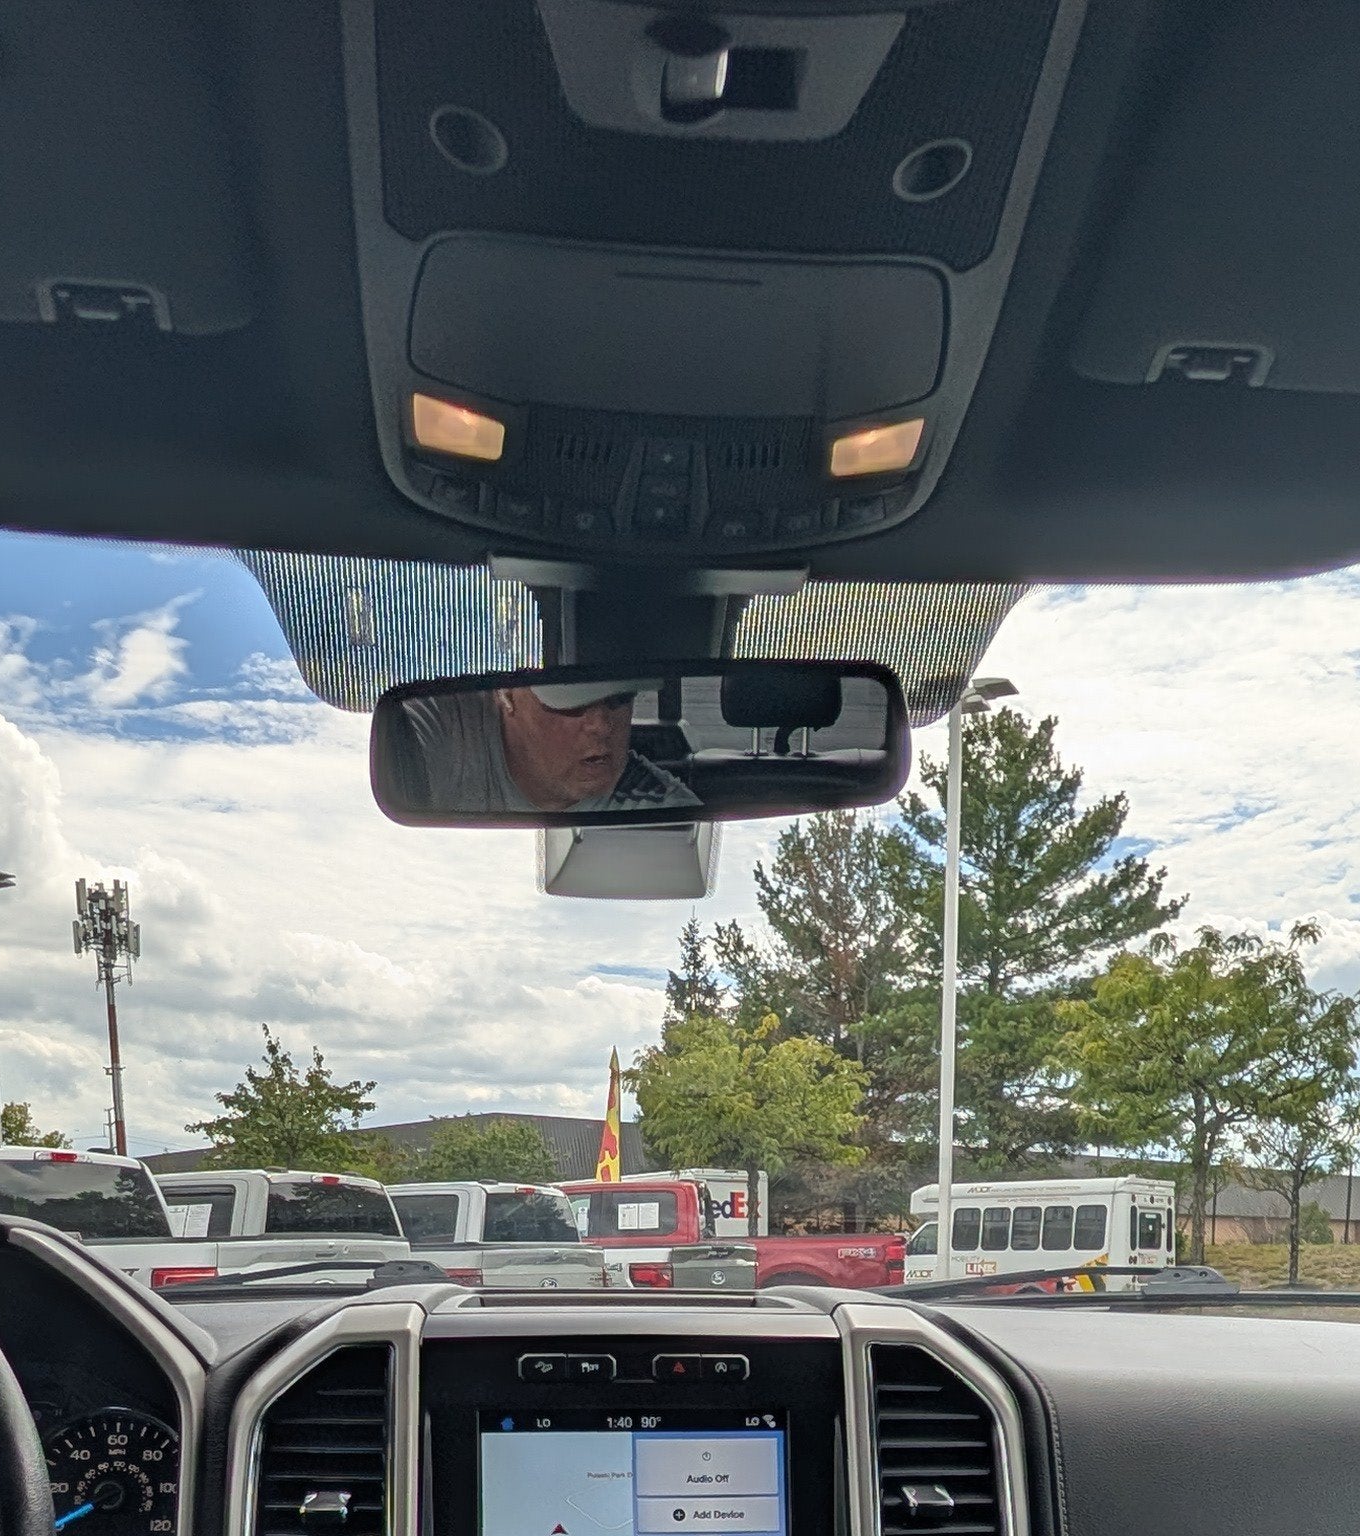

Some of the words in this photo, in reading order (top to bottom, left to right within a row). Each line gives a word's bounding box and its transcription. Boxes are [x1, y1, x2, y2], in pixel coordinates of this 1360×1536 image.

[537, 1419, 551, 1428] LO
[607, 1417, 632, 1428] 1:40
[746, 1417, 759, 1426] LO
[108, 1434, 128, 1445] 60
[70, 1450, 91, 1461] 40
[143, 1450, 163, 1461] 80
[686, 1474, 711, 1484] Audio
[714, 1474, 729, 1484] Off
[693, 1510, 711, 1520] Add
[713, 1510, 745, 1520] Device
[150, 1520, 172, 1531] 120
